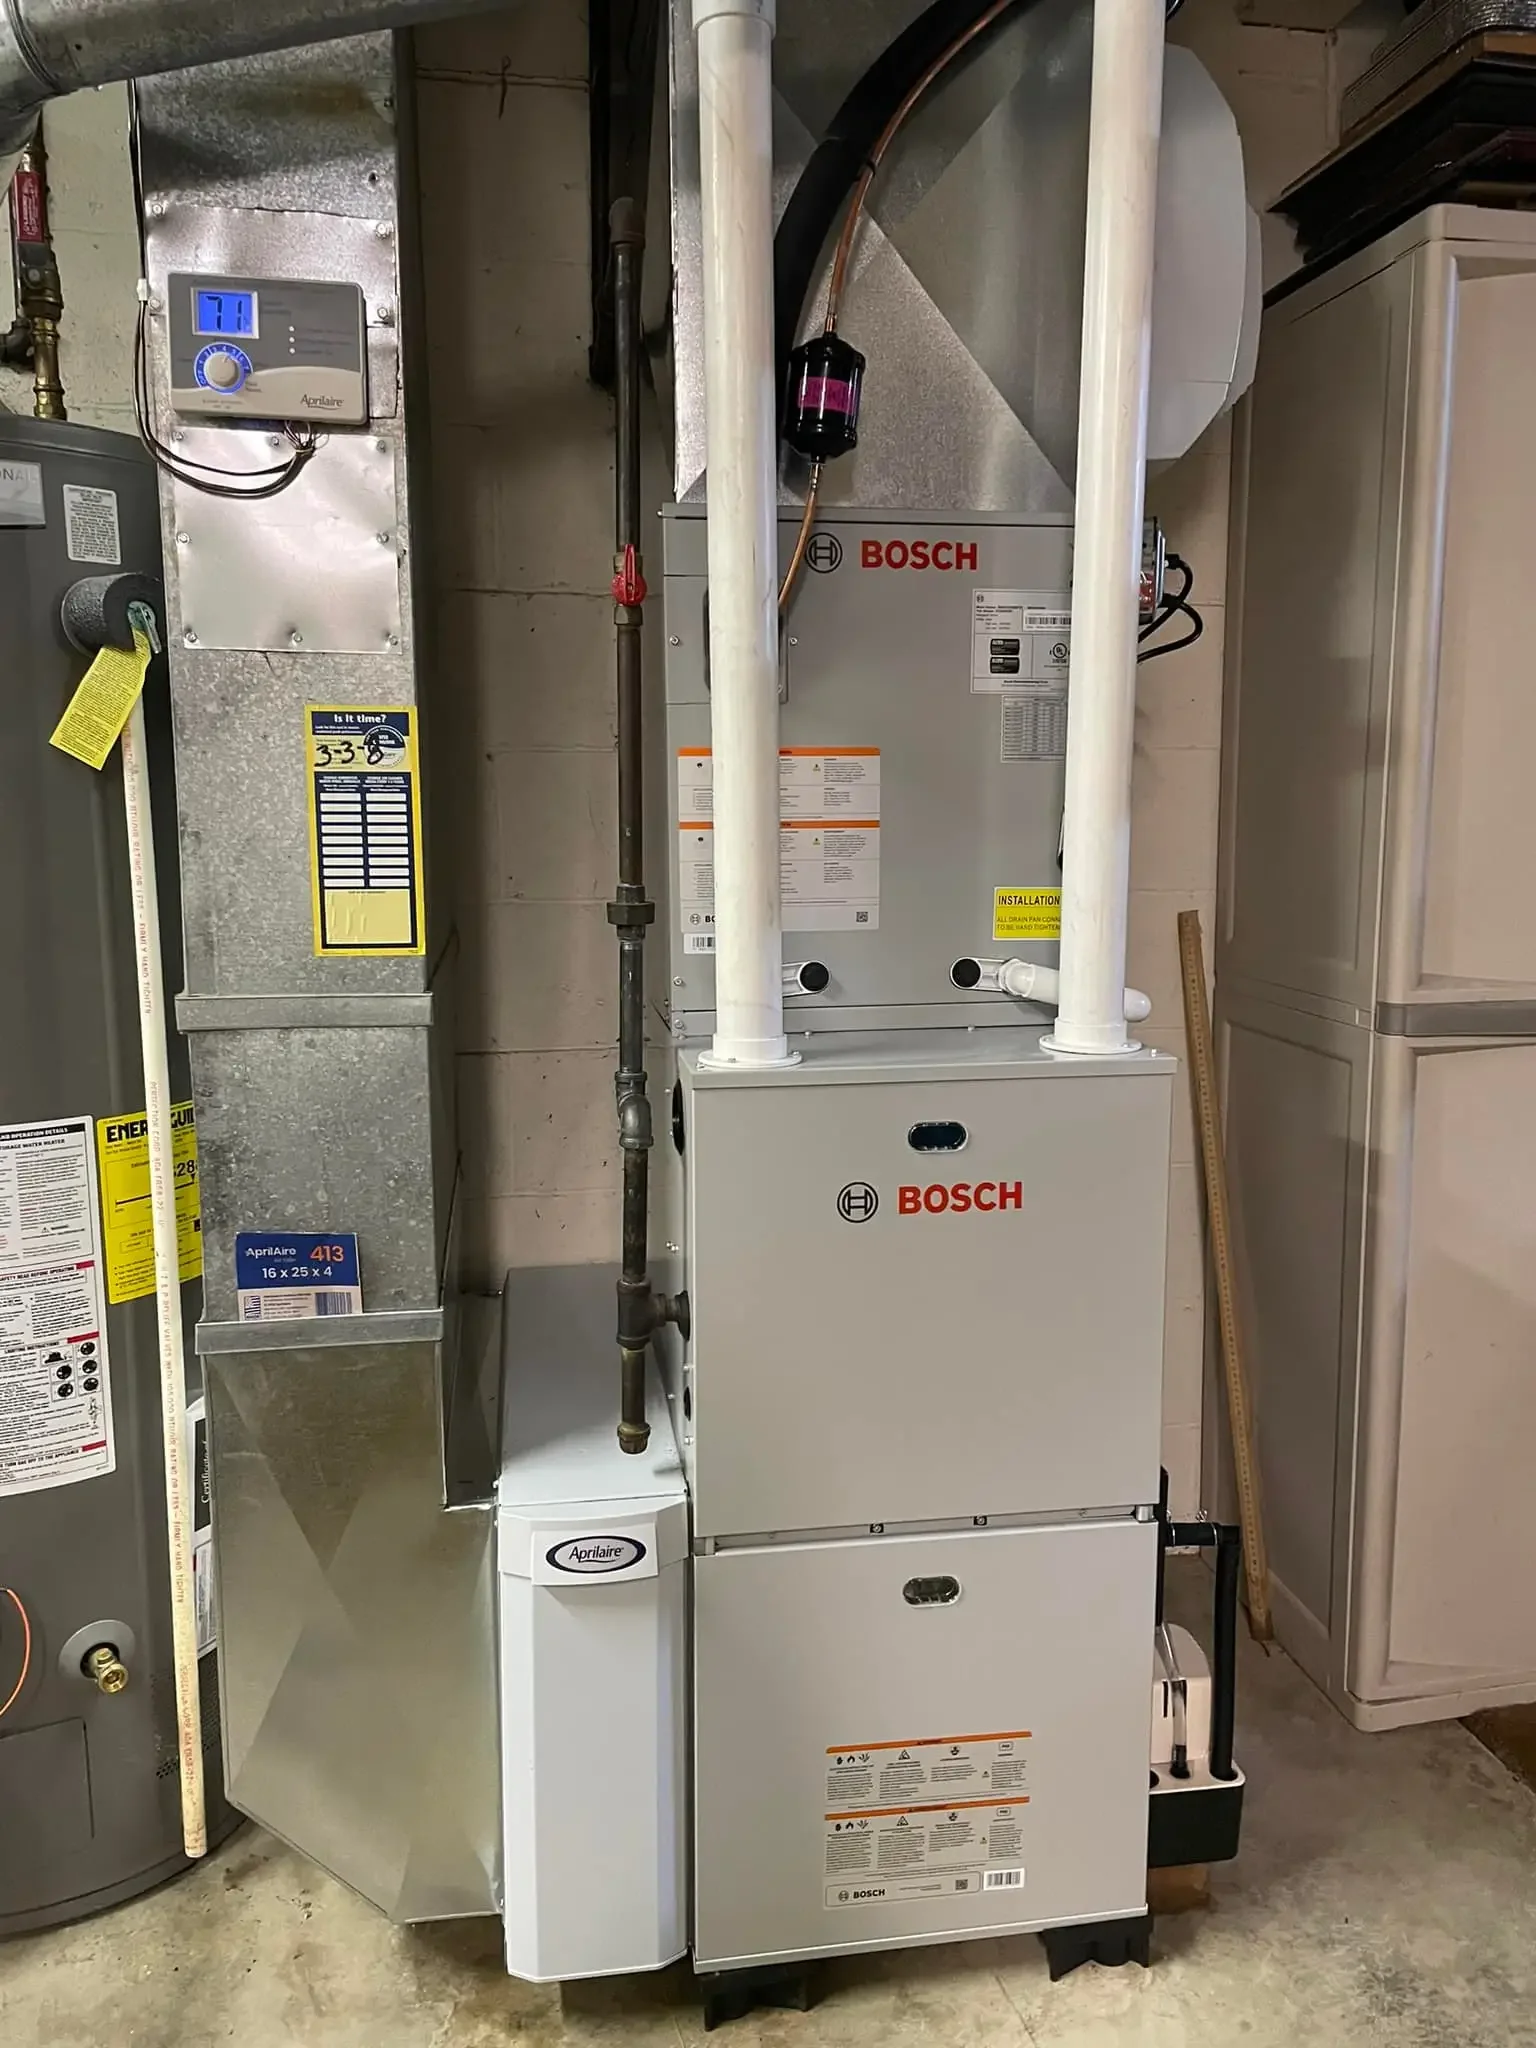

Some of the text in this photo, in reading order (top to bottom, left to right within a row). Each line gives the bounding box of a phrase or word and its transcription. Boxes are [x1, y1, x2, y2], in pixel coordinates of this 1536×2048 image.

[206, 294, 243, 331] 71
[301, 394, 344, 410] Aprilaire
[861, 540, 977, 570] BOSCH
[333, 713, 343, 723] Is
[356, 713, 387, 723] time?
[998, 895, 1061, 906] INSTALLATION
[898, 1181, 1022, 1214] BOSCH
[245, 1245, 345, 1262] AprilAire 413
[262, 1266, 333, 1279] 16 x 25 x 4
[569, 1545, 624, 1563] Aprilaire
[852, 1888, 886, 1899] BOSCH
